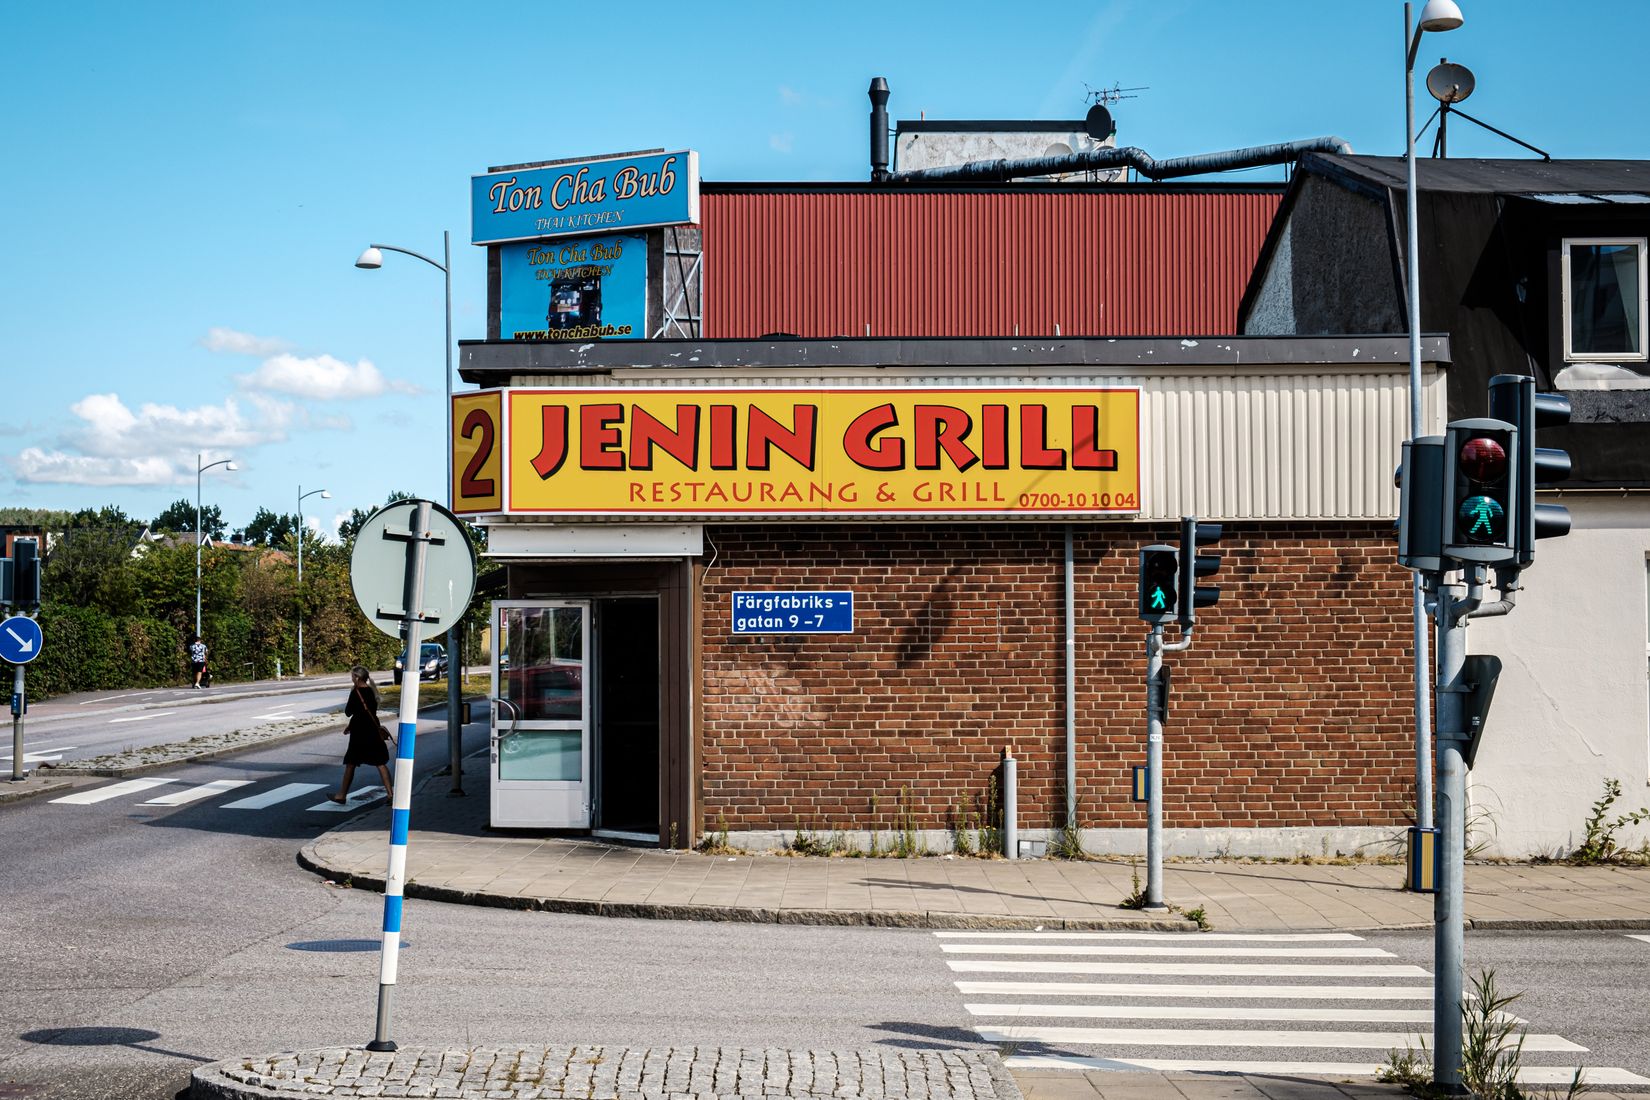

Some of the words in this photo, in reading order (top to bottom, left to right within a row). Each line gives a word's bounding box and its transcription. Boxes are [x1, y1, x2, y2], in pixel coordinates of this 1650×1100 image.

[489, 177, 543, 213] Ton
[551, 167, 607, 210] Cha
[613, 156, 677, 200] Bub
[535, 215, 566, 230] THAI
[567, 209, 625, 227] KITCHEN
[527, 246, 555, 265] Ton
[559, 243, 587, 265] Cha
[590, 239, 623, 261] Bub
[514, 323, 632, 340] www.tonchabub.se
[530, 403, 817, 481] JENIN
[843, 403, 1118, 474] GRILL
[461, 408, 495, 499] 2
[629, 482, 858, 502] RESTAURANG
[875, 482, 896, 502] &
[913, 482, 1006, 502] GRILL
[1019, 493, 1087, 507] 0700-10
[1092, 493, 1111, 507] 10
[1115, 493, 1136, 507] 04
[737, 615, 783, 631] gatan
